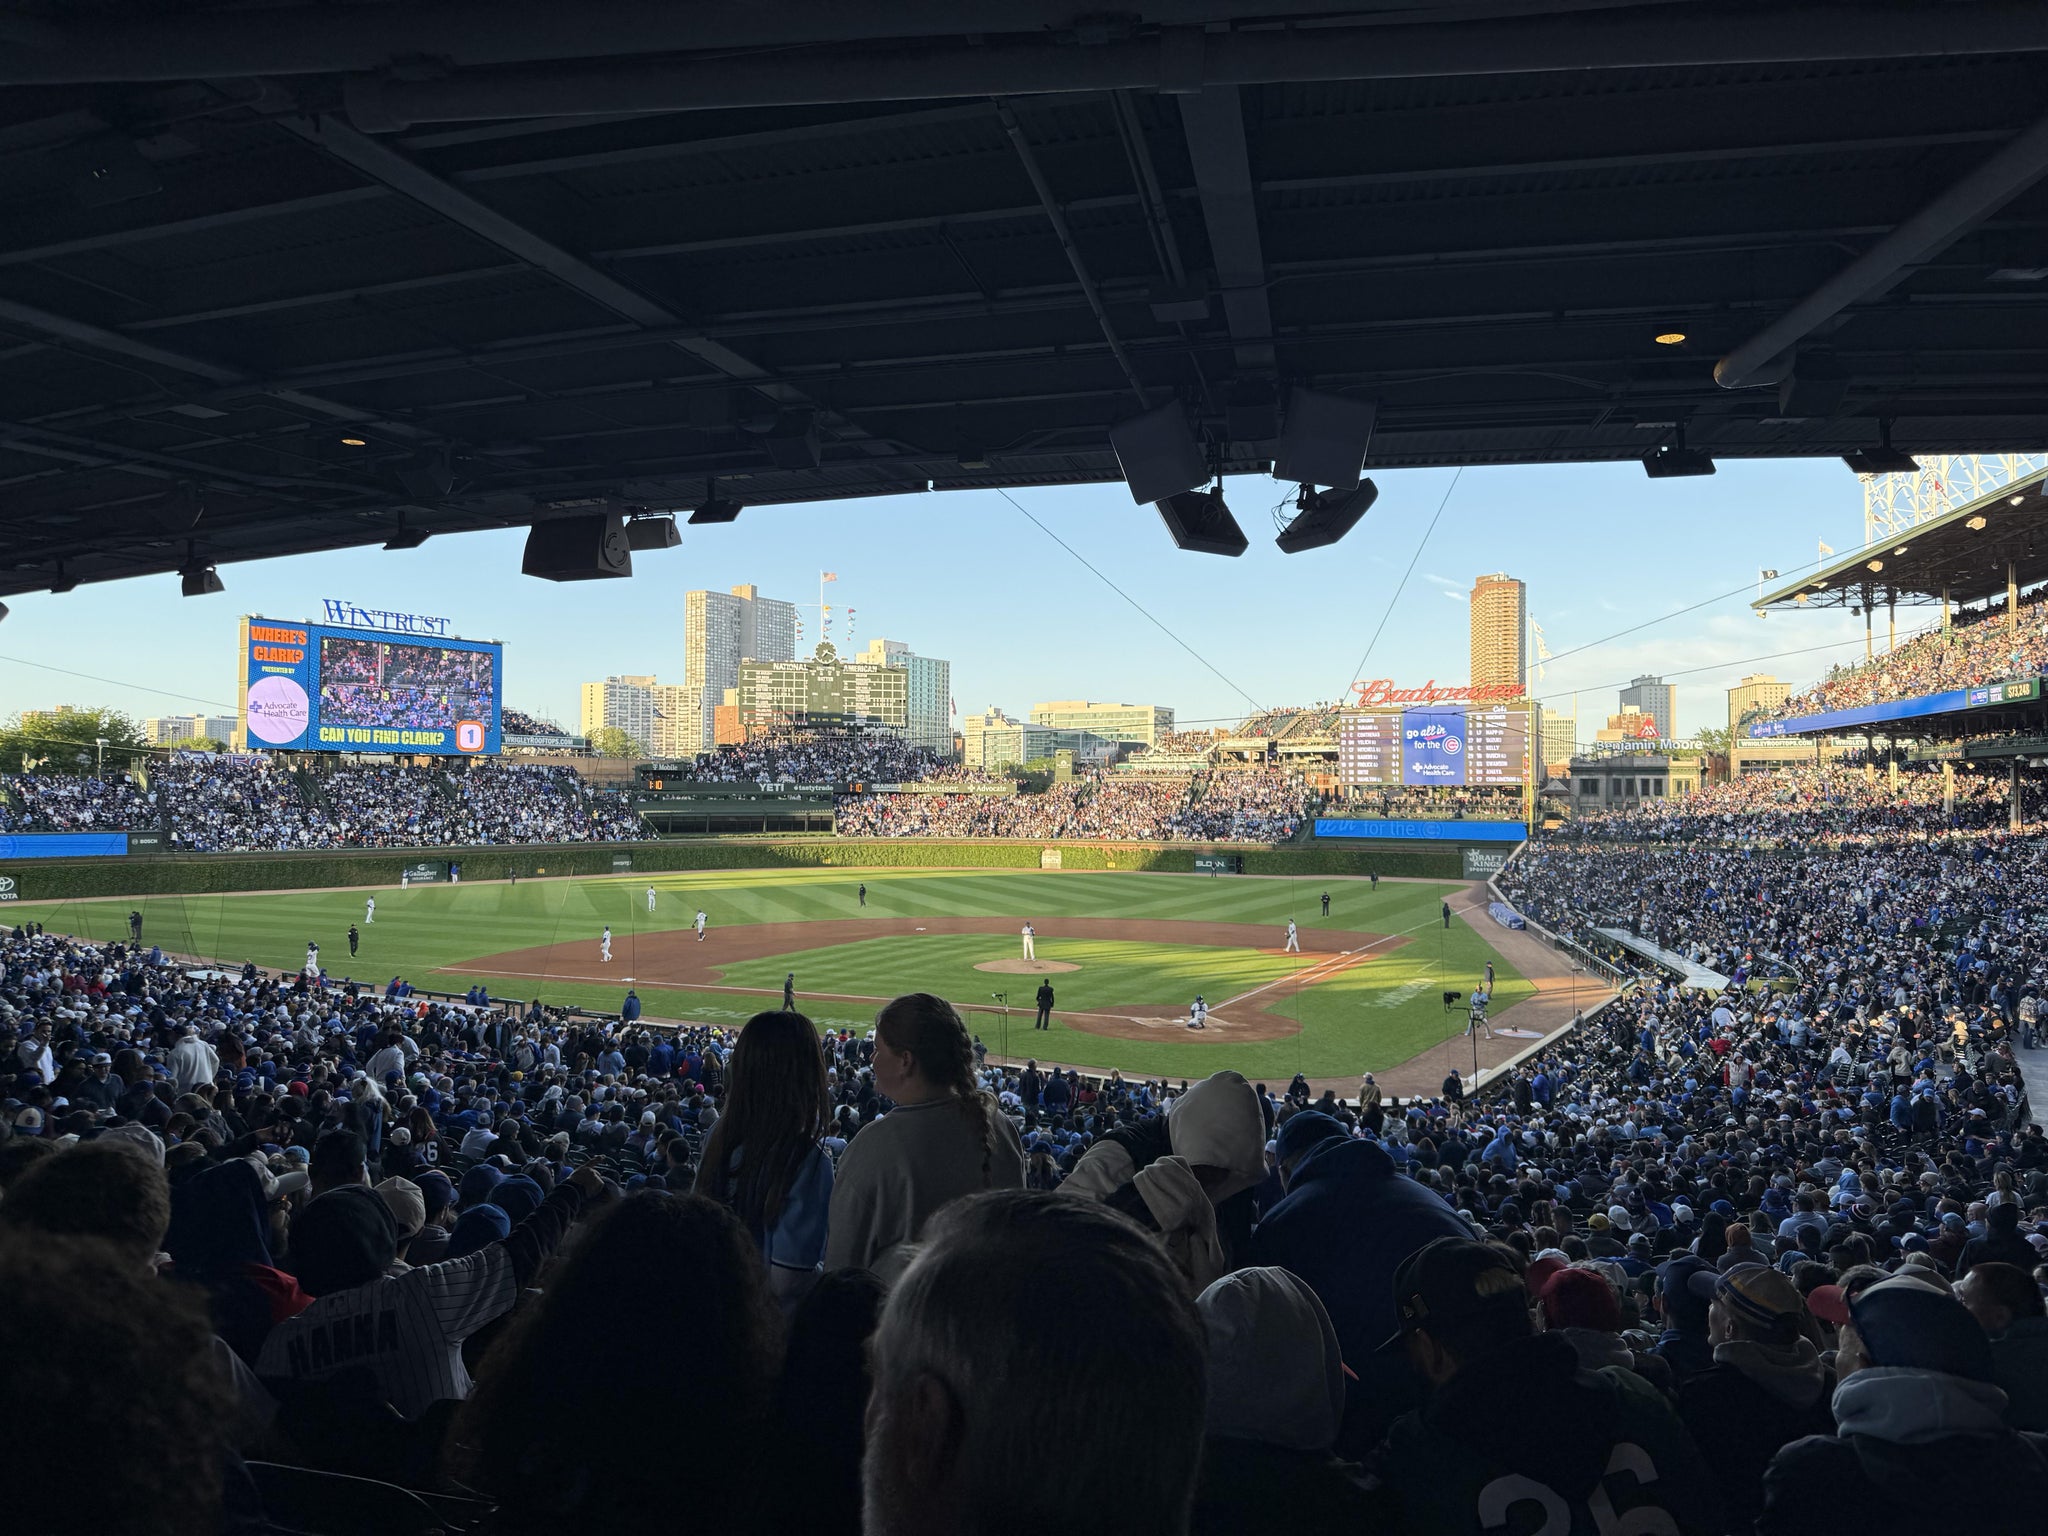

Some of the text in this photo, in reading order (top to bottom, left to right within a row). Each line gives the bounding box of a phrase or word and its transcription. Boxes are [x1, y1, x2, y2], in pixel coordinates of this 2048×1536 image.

[322, 599, 451, 635] WINTRUST
[250, 626, 308, 645] WHERE'S
[253, 646, 304, 664] CLARK?
[773, 662, 809, 671] NATIONAL
[843, 664, 878, 673] AMERICAN
[1352, 679, 1526, 707] Budweiser
[264, 702, 297, 711] Advocate
[264, 710, 288, 718] Health
[320, 728, 474, 746] CAN YOU FIND CLARK? 1
[1407, 730, 1419, 740] go
[1420, 725, 1436, 737] all
[1414, 740, 1426, 749] for
[1427, 740, 1441, 749] the
[1596, 739, 1703, 751] Benjamin Moore
[658, 763, 679, 771] Mobile
[759, 783, 785, 792] YETI
[798, 784, 834, 793] tastytrade
[976, 784, 1007, 793] Advocate
[1363, 820, 1385, 836] for
[1391, 820, 1416, 836] the
[1469, 854, 1504, 862] DRAFT
[1195, 860, 1225, 868] SLON
[409, 870, 437, 878] Gallagher
[0, 892, 18, 900] OTA
